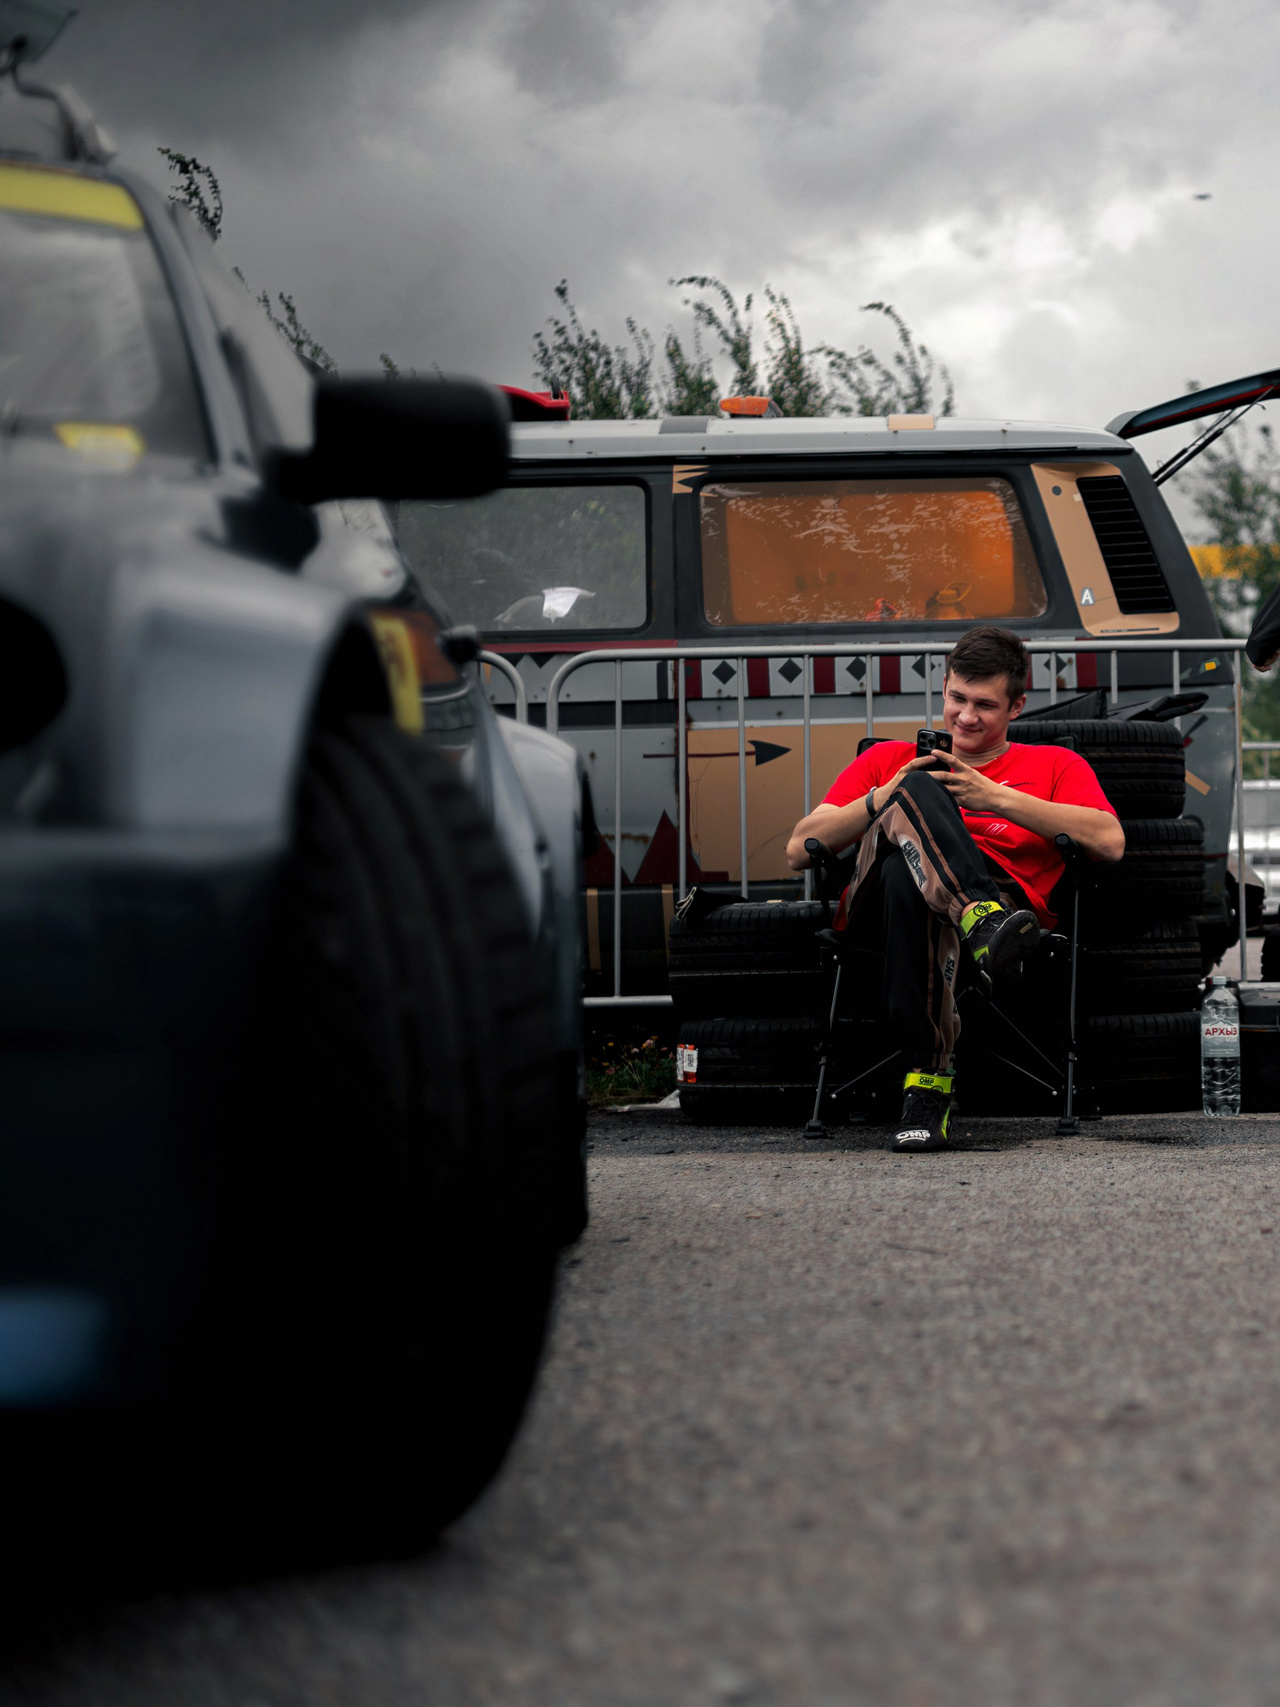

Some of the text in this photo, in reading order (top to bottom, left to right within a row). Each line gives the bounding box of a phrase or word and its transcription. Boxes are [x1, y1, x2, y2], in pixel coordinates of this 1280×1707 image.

[1081, 588, 1094, 605] A
[1205, 1027, 1238, 1036] АРХЫЗ
[895, 1129, 931, 1140] OMP
